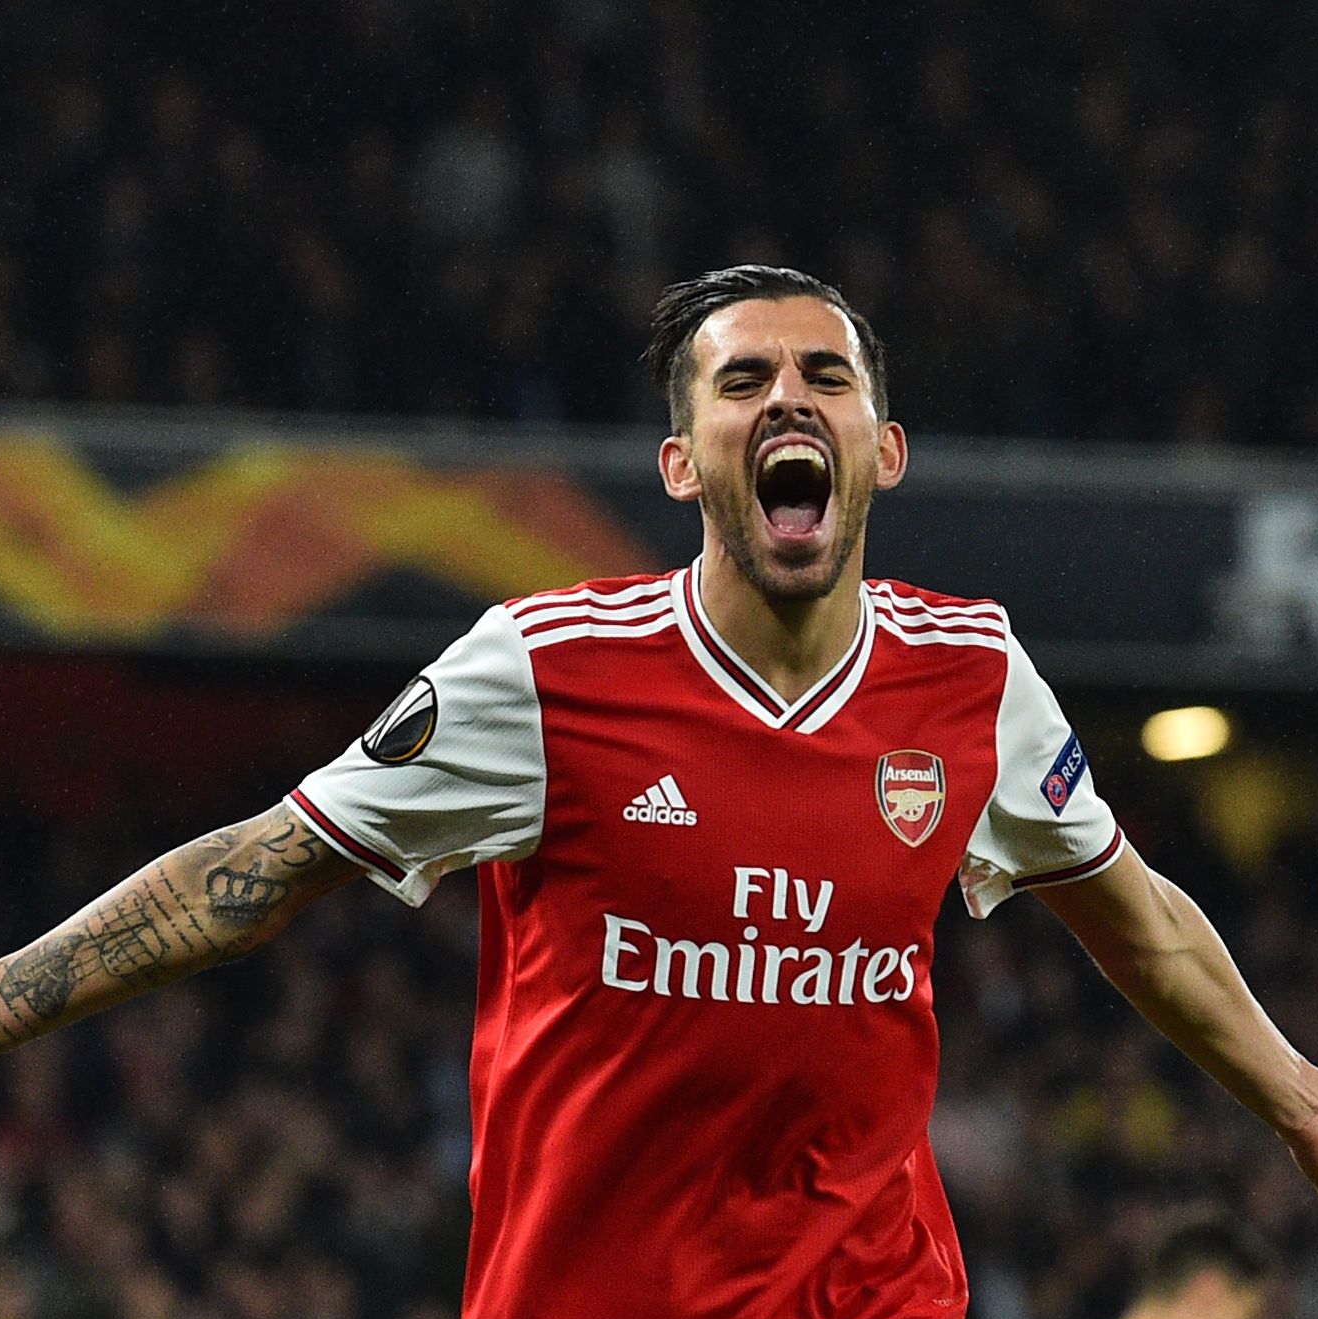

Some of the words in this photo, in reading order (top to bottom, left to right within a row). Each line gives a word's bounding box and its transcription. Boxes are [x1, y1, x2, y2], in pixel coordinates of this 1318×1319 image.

[885, 766, 935, 782] Arsenal
[622, 804, 698, 826] adidas
[732, 866, 834, 933] Fly
[602, 913, 920, 1006] Emirates
